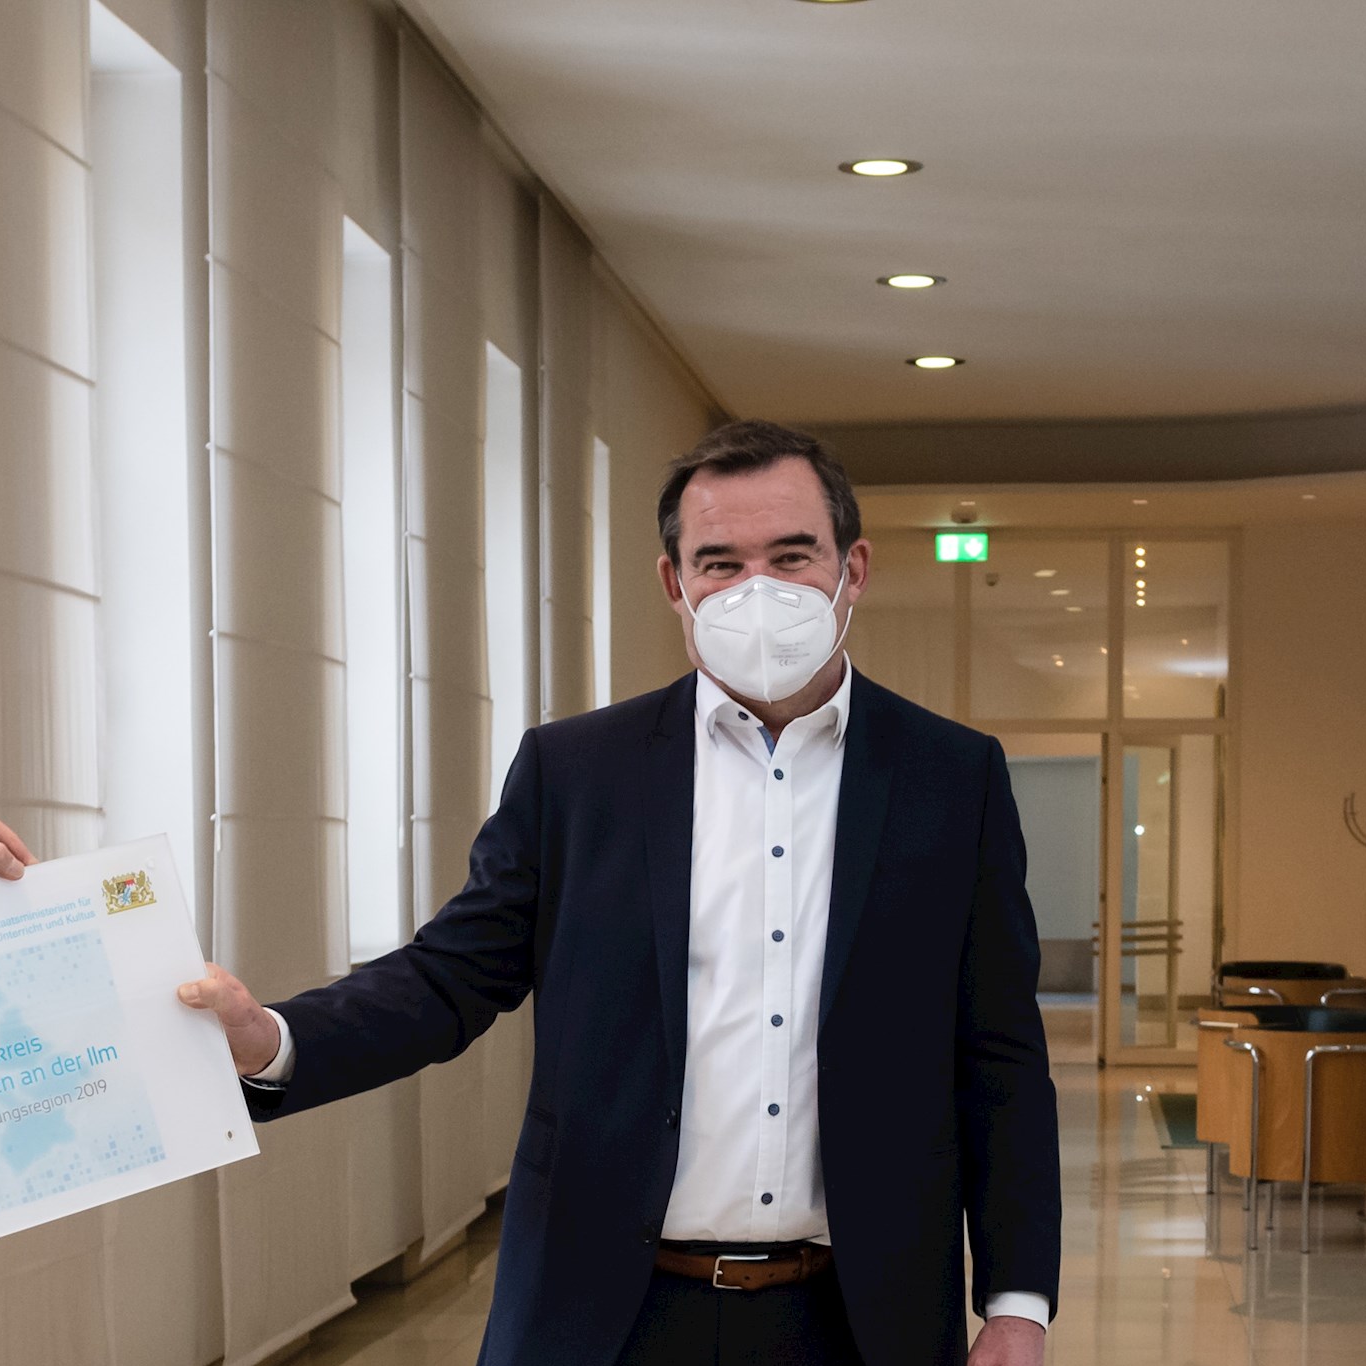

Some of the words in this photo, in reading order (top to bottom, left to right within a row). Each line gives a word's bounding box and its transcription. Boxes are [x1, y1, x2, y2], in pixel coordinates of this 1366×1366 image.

[77, 897, 92, 912] für
[45, 917, 64, 931] und
[66, 910, 96, 926] Kultus
[20, 1066, 46, 1086] an
[51, 1055, 83, 1077] der
[74, 1079, 108, 1101] 2019
